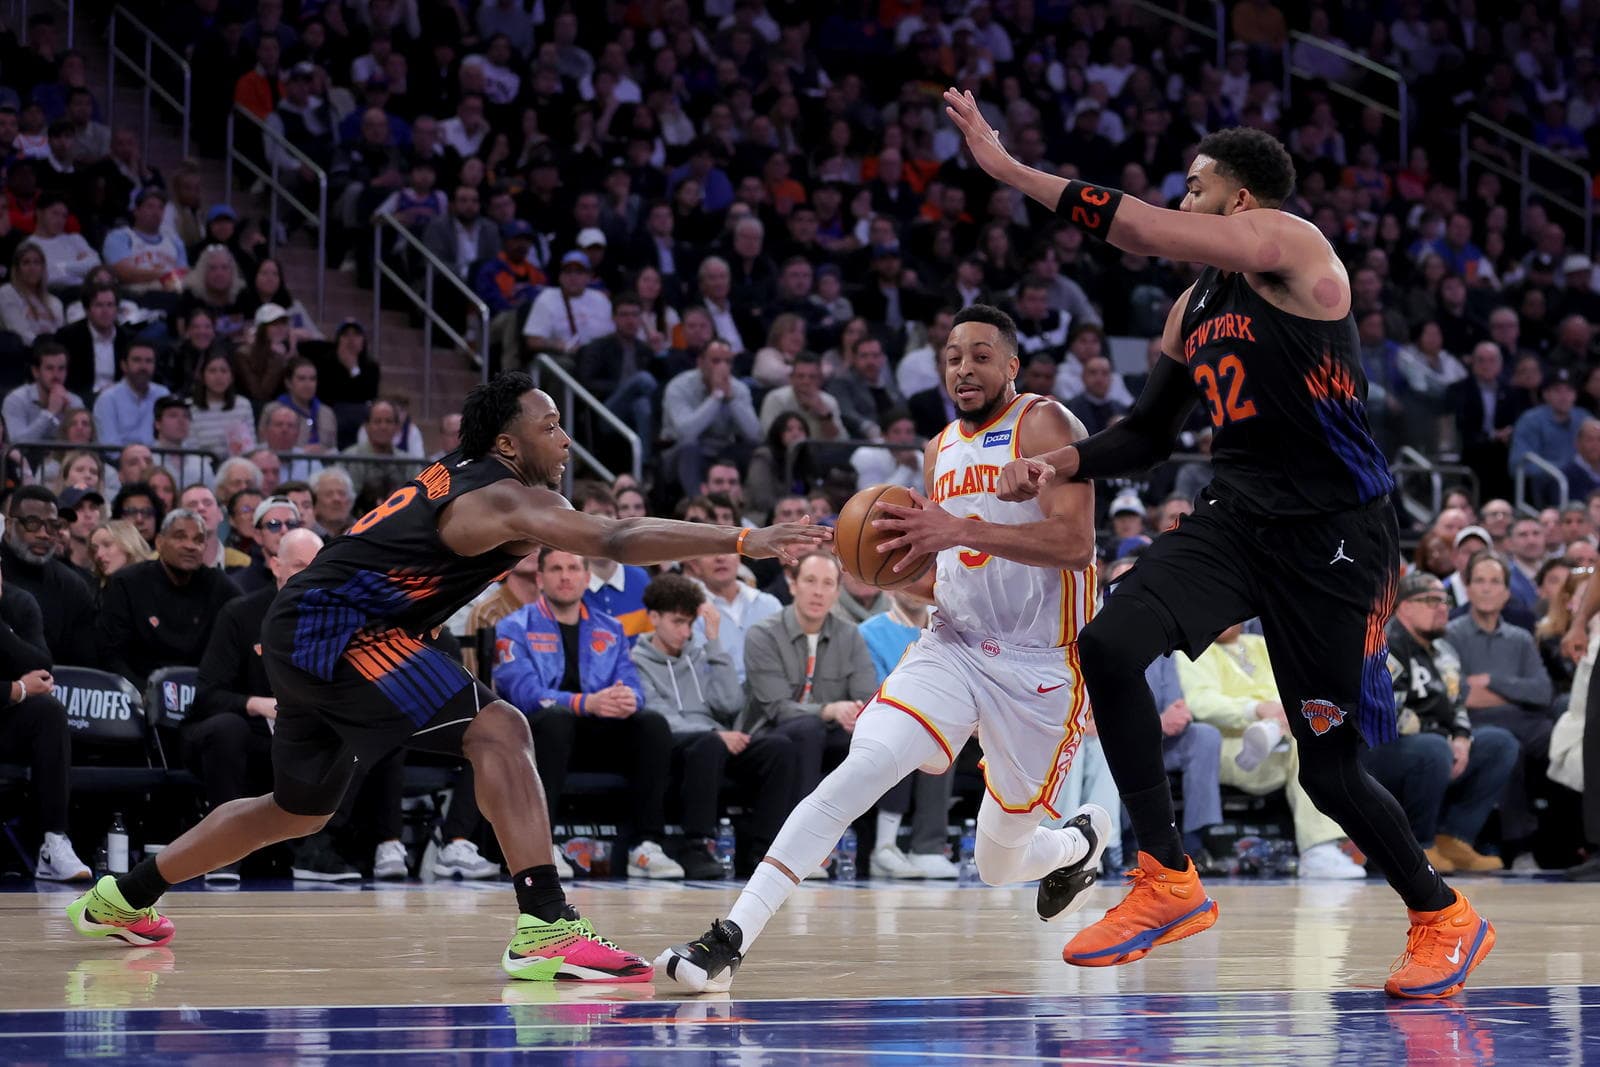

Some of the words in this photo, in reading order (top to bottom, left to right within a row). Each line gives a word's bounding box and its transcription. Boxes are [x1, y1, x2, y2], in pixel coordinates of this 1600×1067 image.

[1072, 186, 1110, 229] 32
[1212, 313, 1256, 342] YORK
[1193, 354, 1257, 427] 32
[985, 432, 1010, 444] paze
[931, 464, 1003, 504] ATLANT
[345, 486, 418, 535] 8
